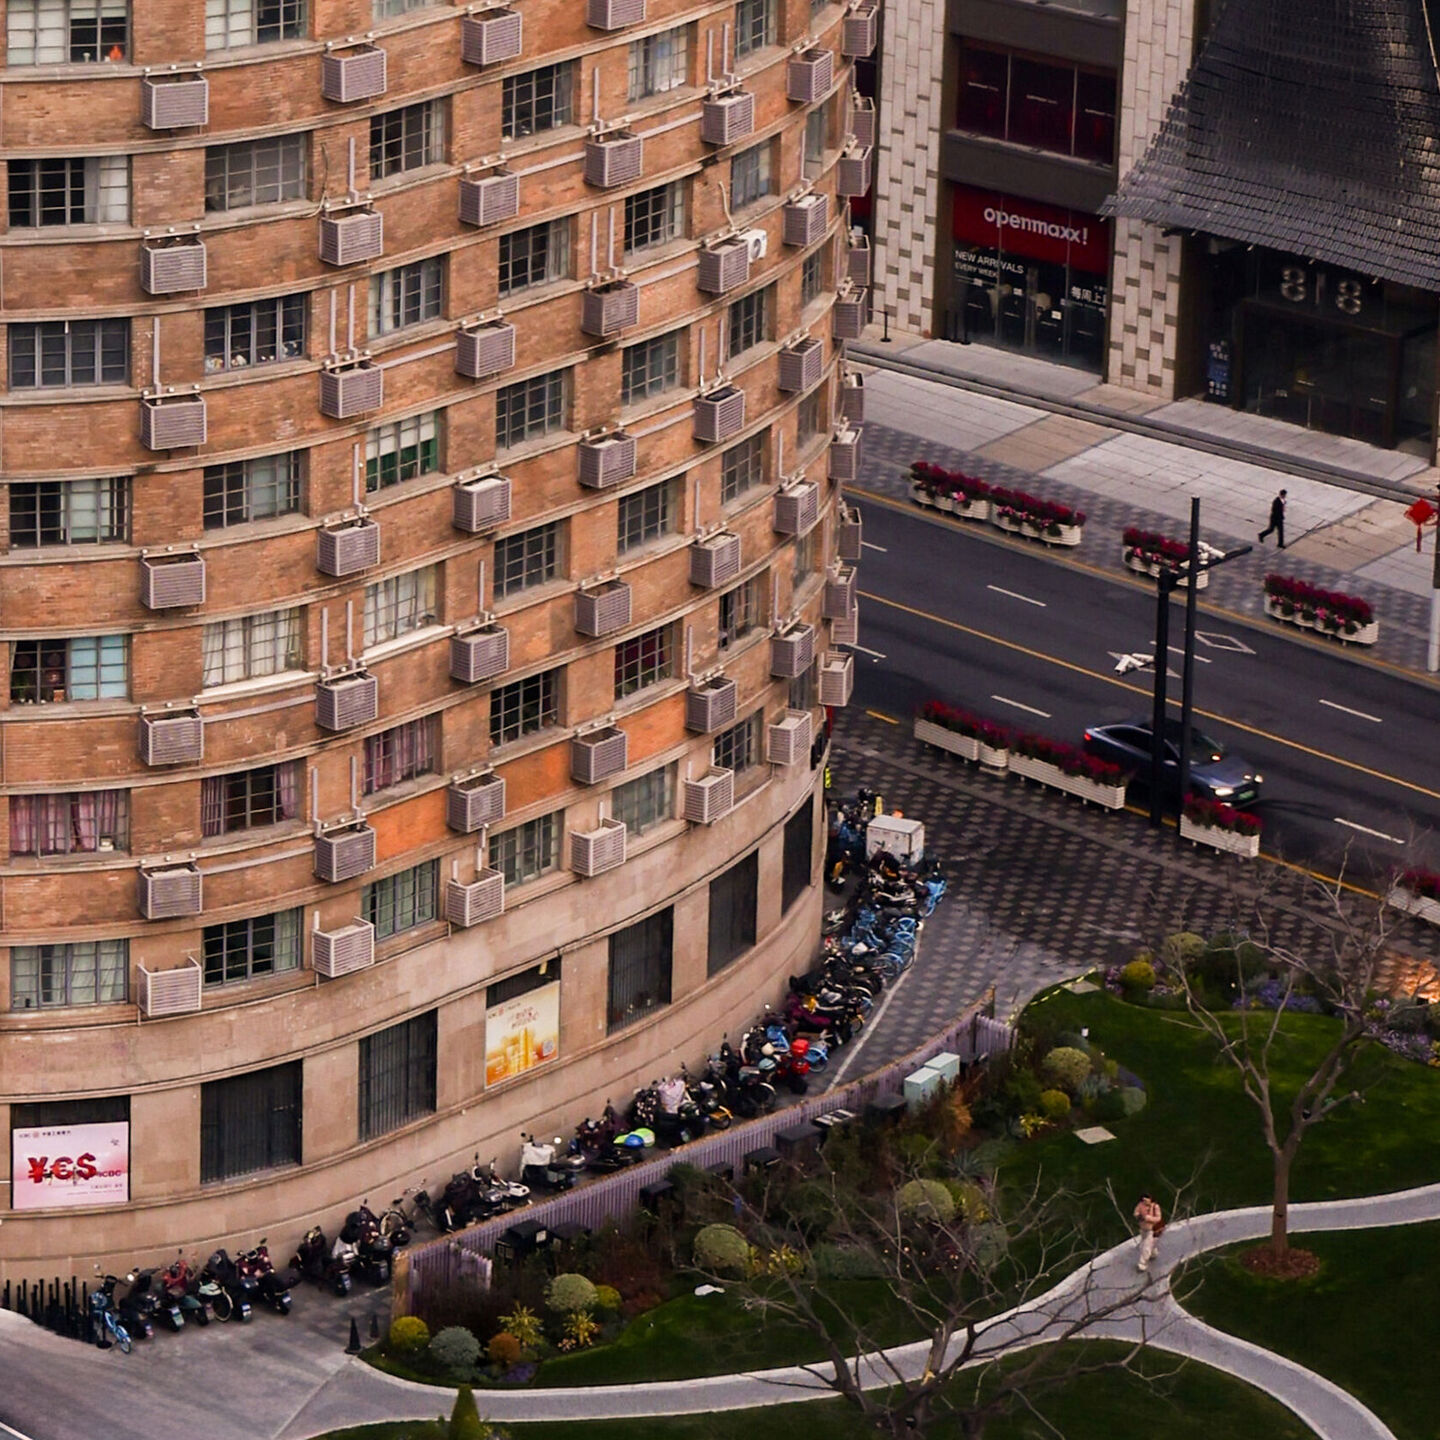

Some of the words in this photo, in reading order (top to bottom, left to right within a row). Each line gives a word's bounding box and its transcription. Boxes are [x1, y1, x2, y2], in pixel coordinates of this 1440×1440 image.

[984, 207, 1088, 246] openmaxx!
[955, 250, 976, 263] NEW
[1280, 266, 1361, 315] 818
